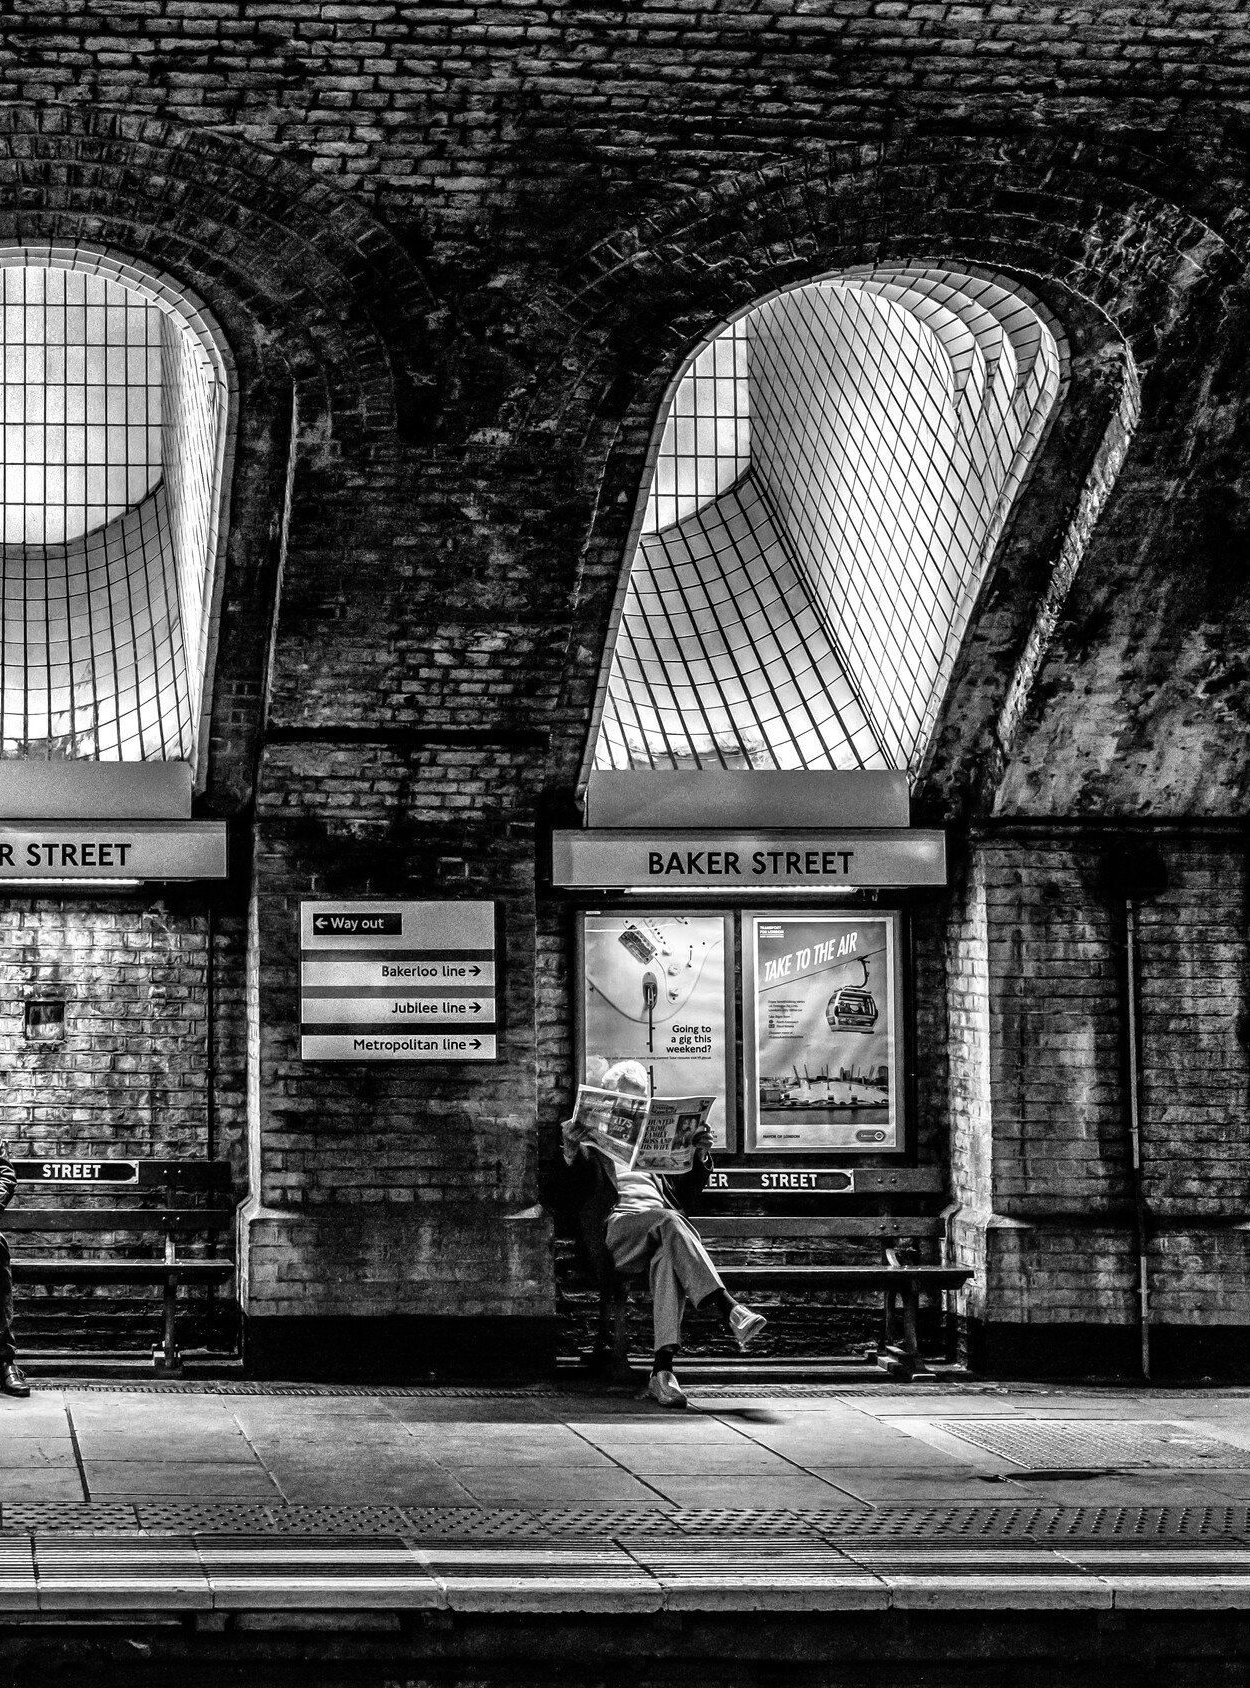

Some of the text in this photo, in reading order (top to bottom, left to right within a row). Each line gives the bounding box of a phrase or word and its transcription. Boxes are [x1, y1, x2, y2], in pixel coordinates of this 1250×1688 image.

[26, 843, 132, 866] STREET
[648, 851, 854, 875] BAKER STREET
[330, 917, 384, 932] Way out
[764, 931, 858, 982] TAKE TO THE AIR
[381, 965, 466, 977] Bakerloo line
[391, 1002, 466, 1014] Jubilee line
[672, 1024, 699, 1034] Going
[353, 1039, 467, 1053] Metropolitan line
[678, 1035, 692, 1045] gig
[694, 1035, 712, 1043] this
[666, 1045, 712, 1053] weekend?
[42, 1164, 102, 1178] STREET
[761, 1174, 818, 1187] STREET
